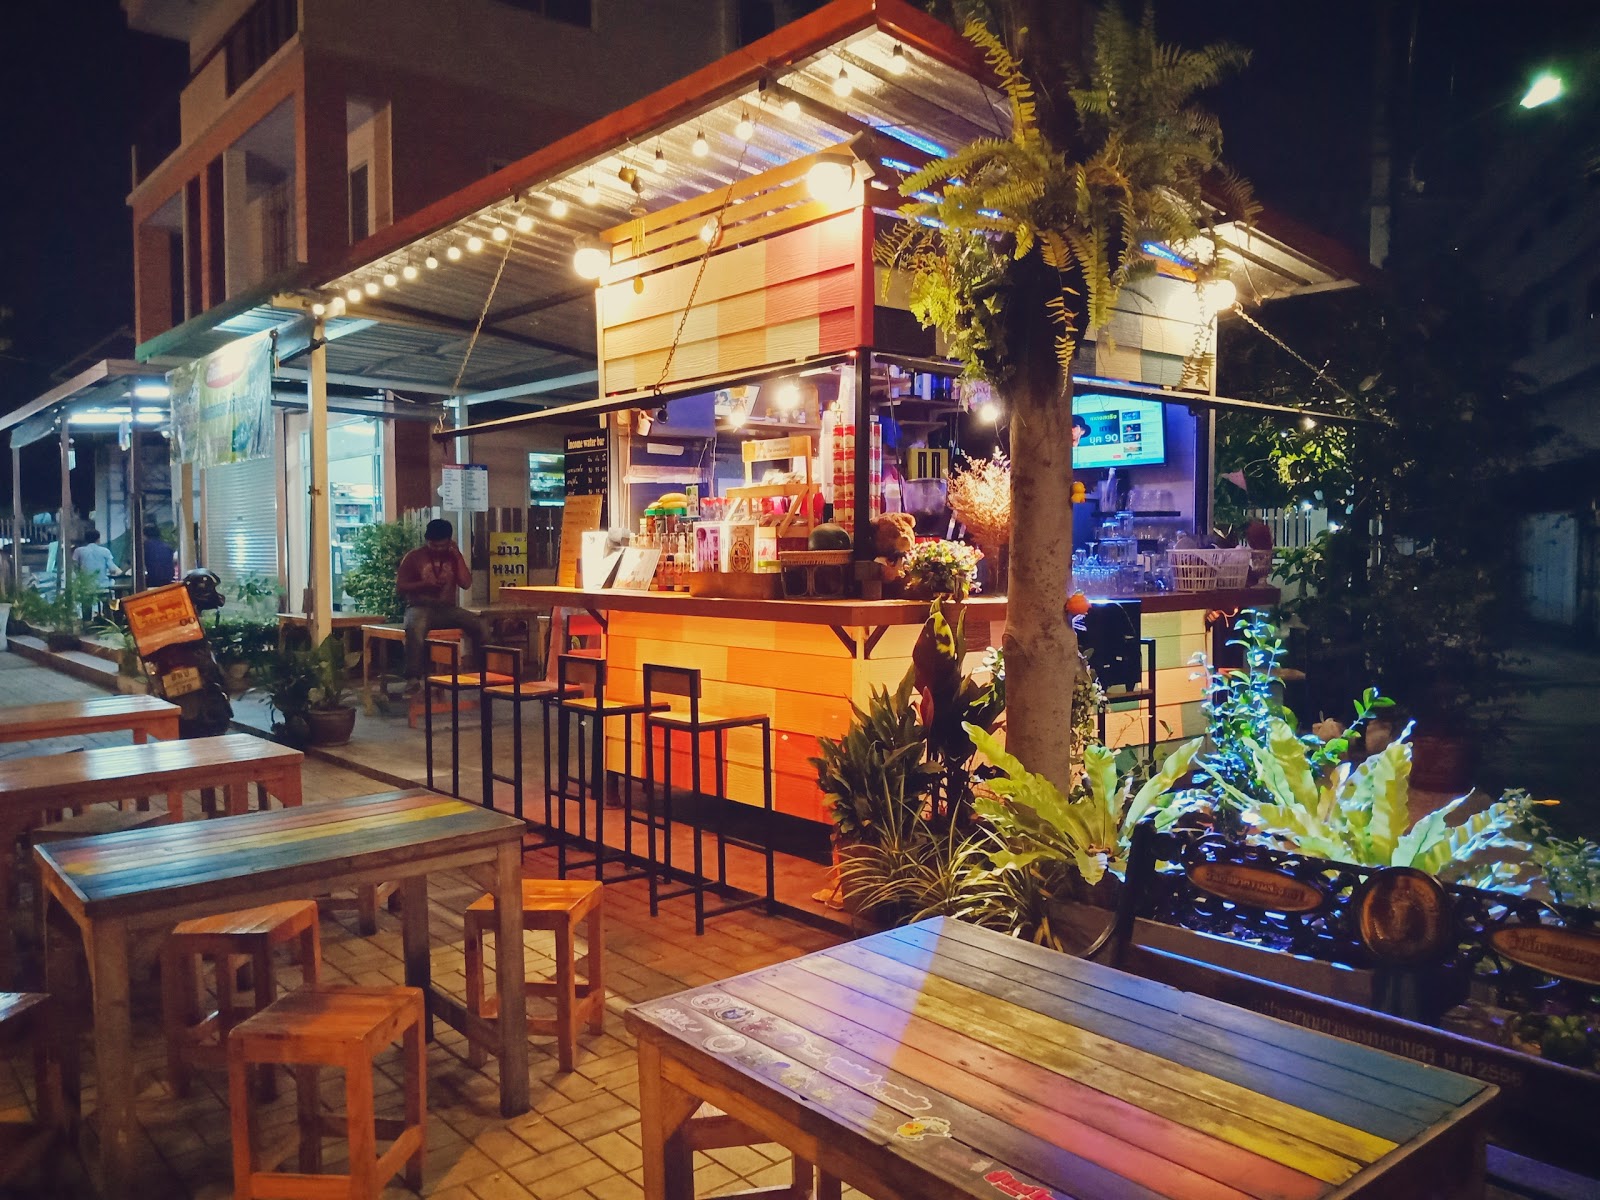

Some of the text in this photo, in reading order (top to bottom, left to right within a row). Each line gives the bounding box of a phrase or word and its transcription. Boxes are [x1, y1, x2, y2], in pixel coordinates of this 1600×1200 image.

[567, 435, 605, 450] Income water bar
[1089, 433, 1119, 446] ยุค 90
[497, 541, 520, 556] ข้าว
[492, 564, 525, 575] หมก
